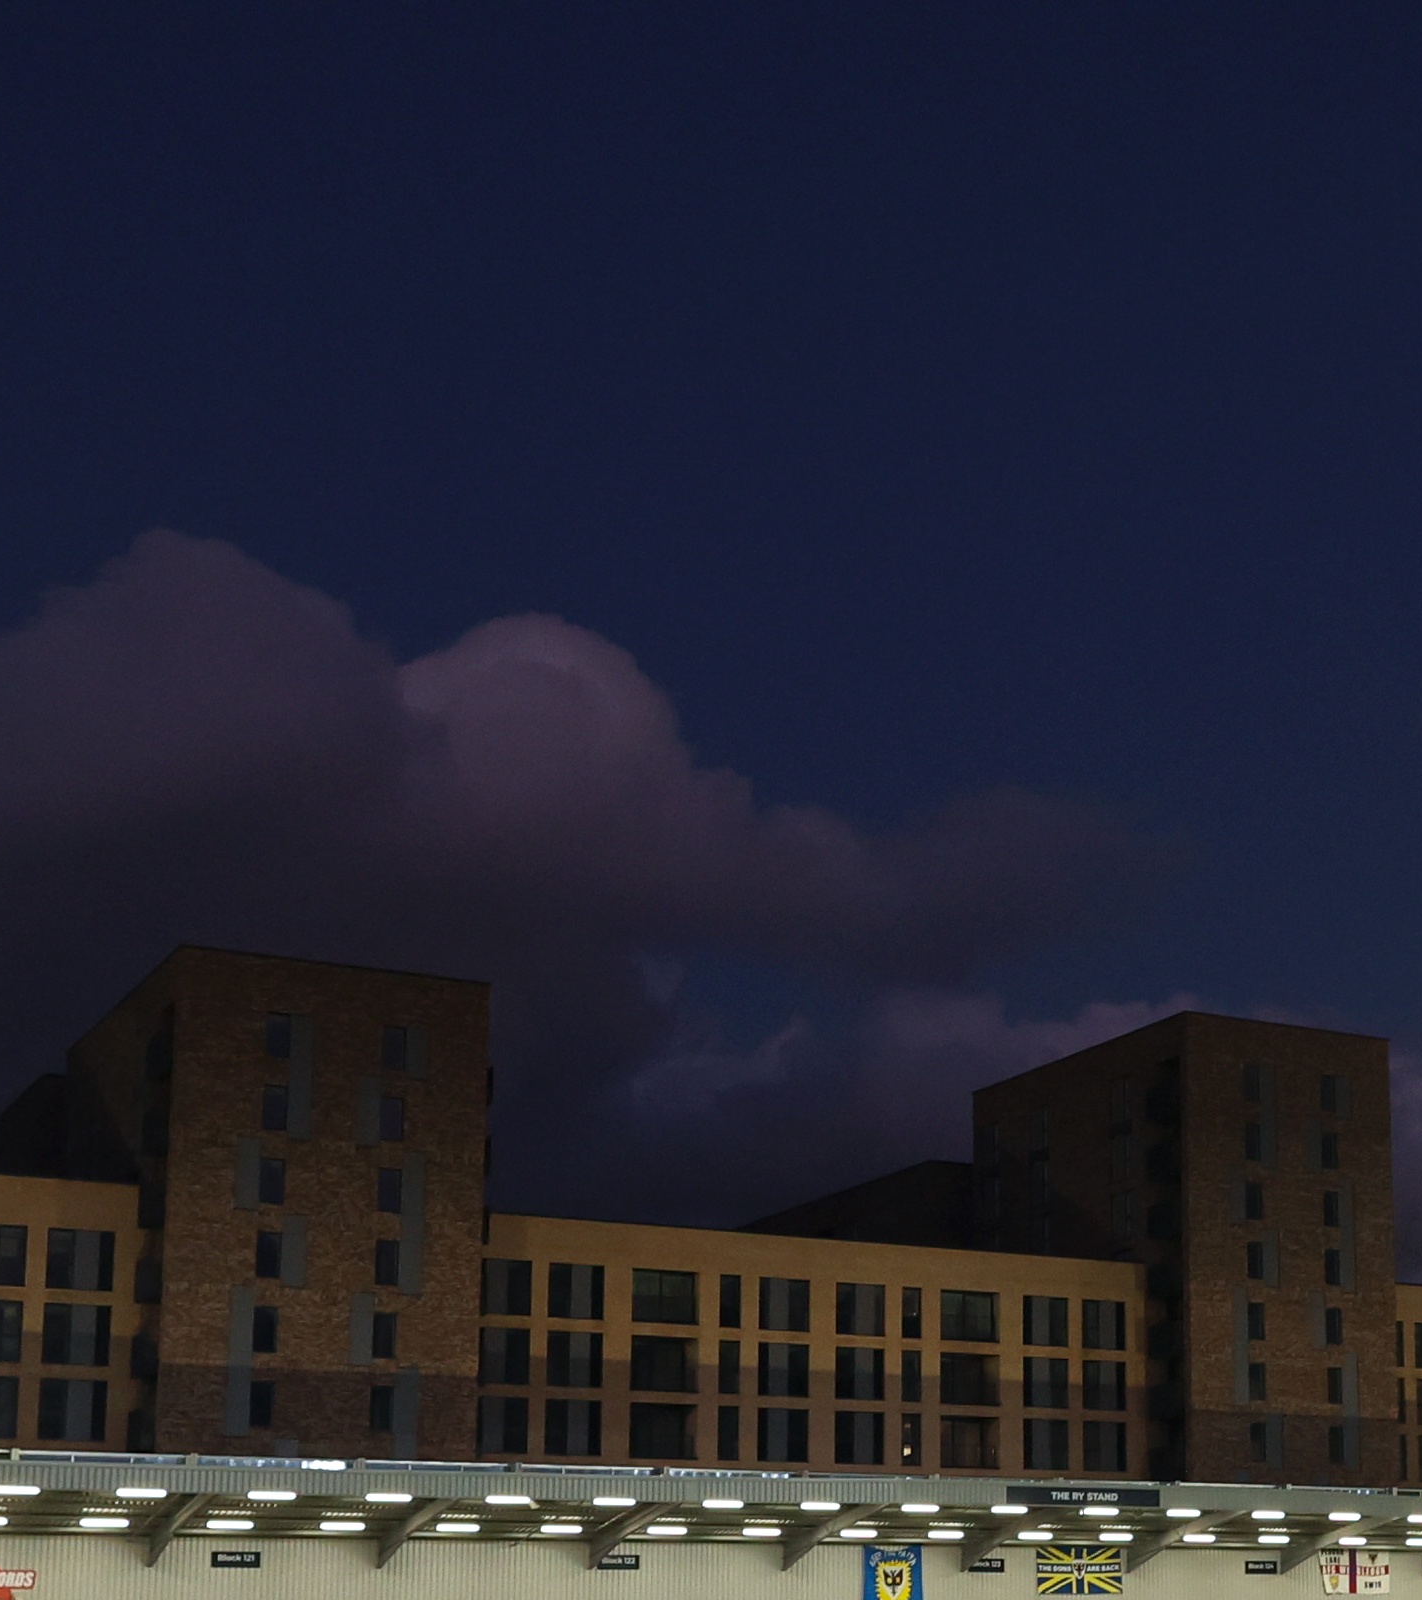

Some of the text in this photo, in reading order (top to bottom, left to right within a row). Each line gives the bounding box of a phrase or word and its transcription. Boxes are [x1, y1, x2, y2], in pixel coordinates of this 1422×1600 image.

[1051, 1491, 1119, 1502] THE RY STAND
[1038, 1564, 1052, 1572] THE
[1087, 1564, 1100, 1572] ARE
